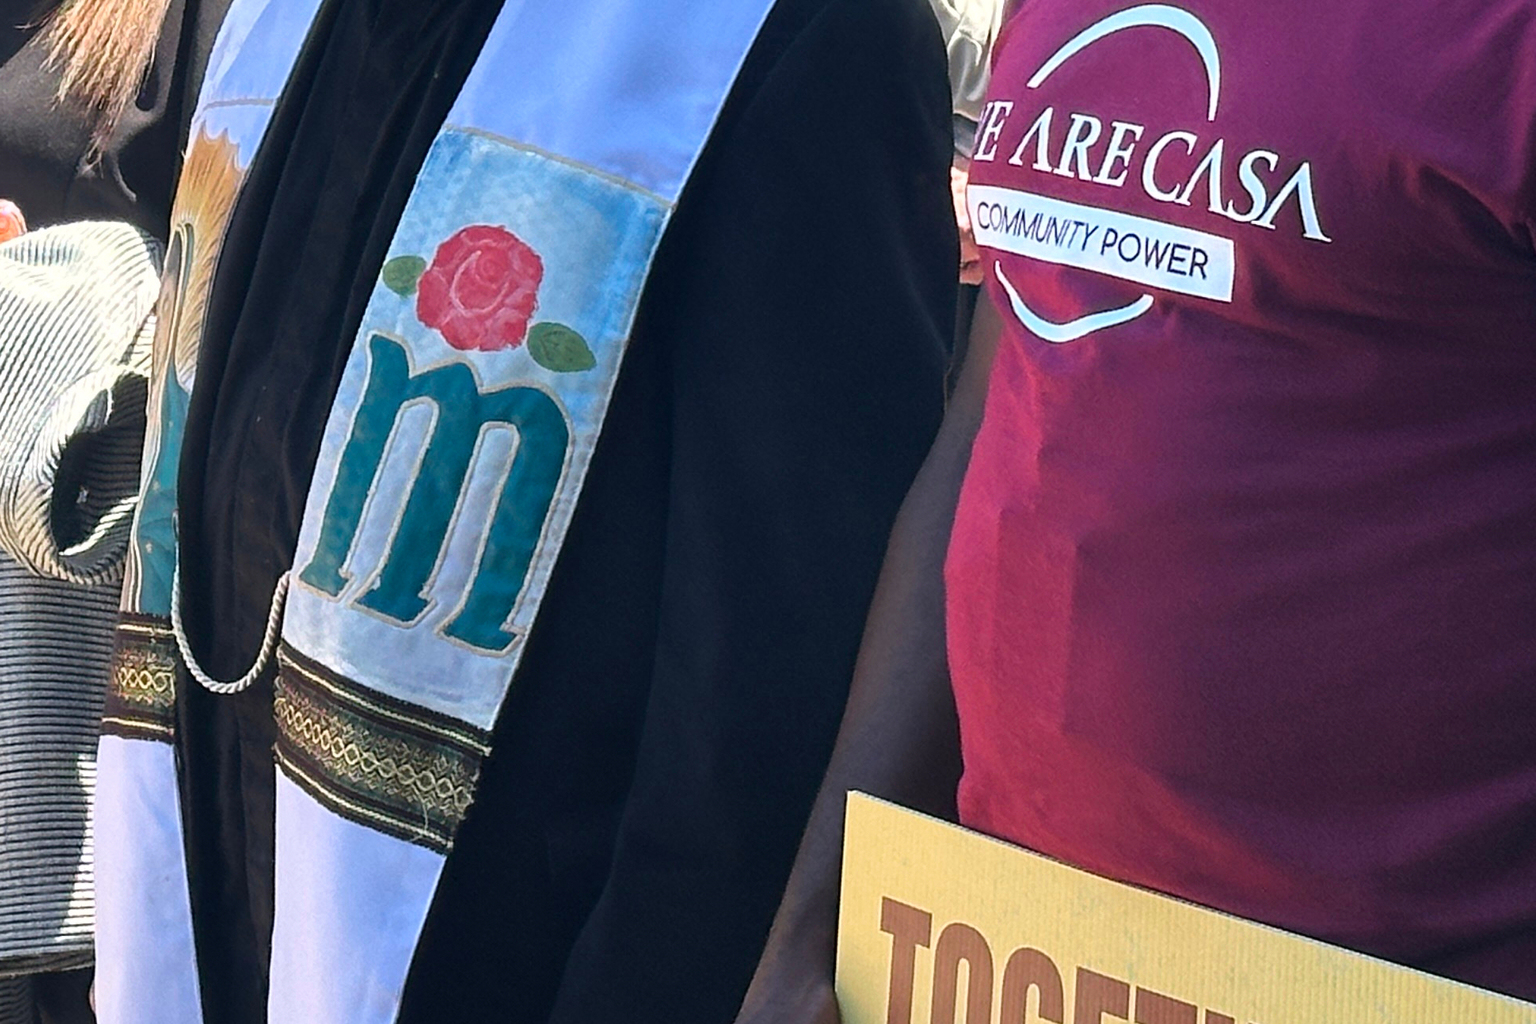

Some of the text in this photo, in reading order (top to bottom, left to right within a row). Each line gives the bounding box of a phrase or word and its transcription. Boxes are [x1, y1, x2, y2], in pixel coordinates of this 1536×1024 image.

[1007, 106, 1146, 188] ARE
[1141, 129, 1333, 243] CASA
[976, 200, 1210, 280] COMMUNITY POWER
